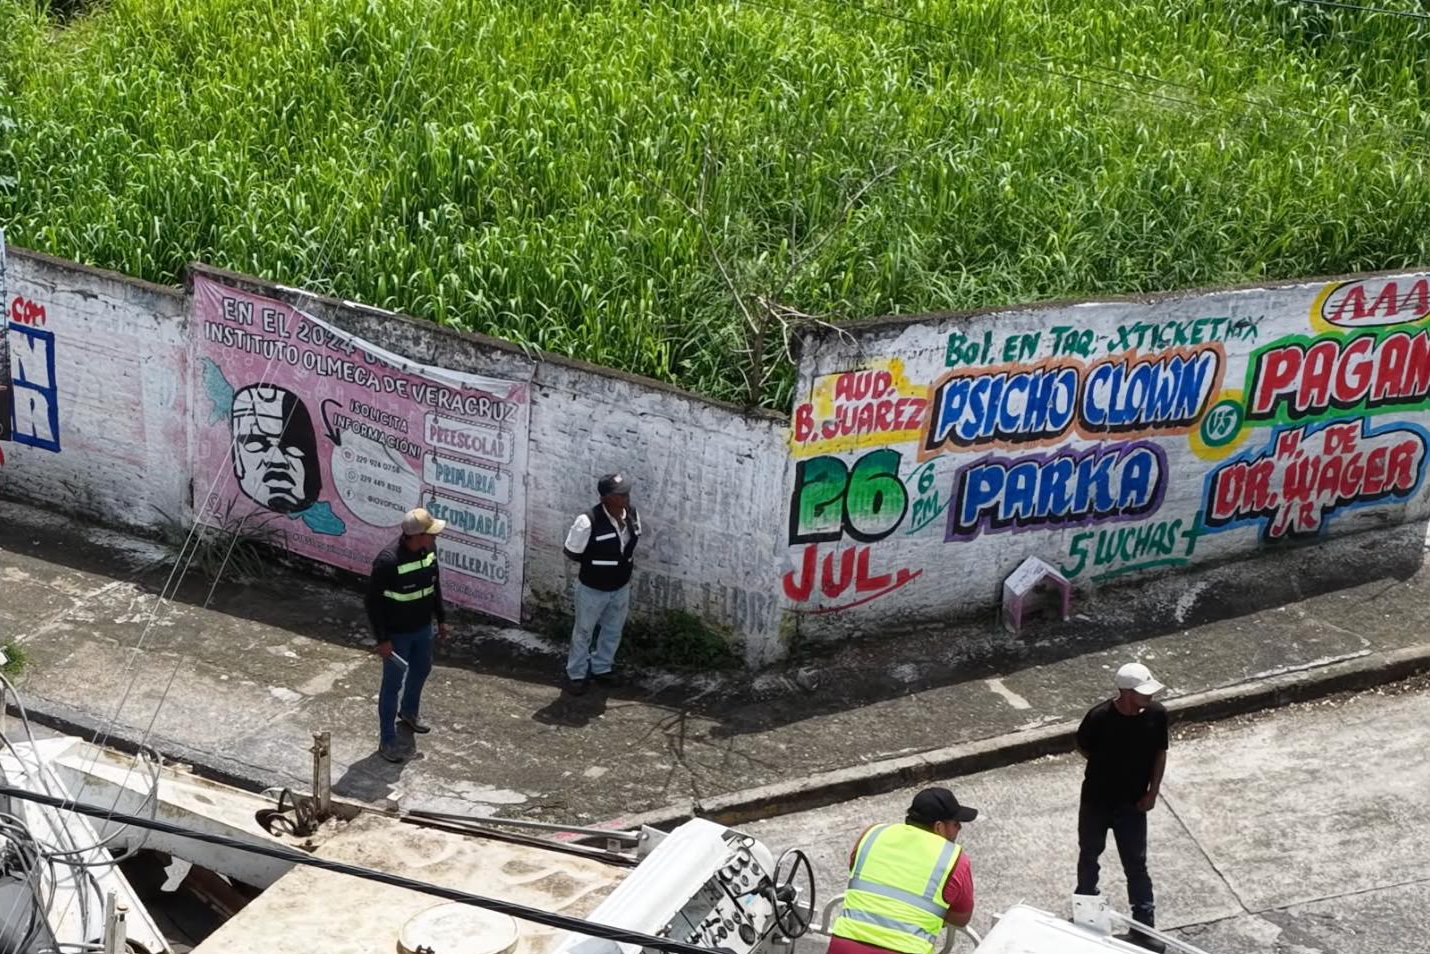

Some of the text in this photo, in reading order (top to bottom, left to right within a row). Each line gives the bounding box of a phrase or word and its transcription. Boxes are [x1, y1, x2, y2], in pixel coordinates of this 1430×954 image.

[222, 296, 254, 326] EN
[262, 308, 291, 339] EL
[1003, 331, 1041, 362] EN
[204, 320, 300, 366] INSTITUTO
[302, 350, 381, 393] OLMECA
[382, 373, 411, 400] DE
[411, 381, 519, 425] VERACRUZ
[835, 371, 896, 400] AUD.
[934, 350, 1217, 443] PSICHO CLOWN
[795, 397, 927, 443] B. JUAREZ
[430, 423, 505, 459] PREESCOLAR
[1324, 424, 1359, 456] DE
[435, 462, 496, 496] PRIMARIA
[789, 449, 908, 546] 26
[916, 462, 935, 494] 6
[960, 449, 1153, 527] PARKA
[426, 501, 507, 540] SECUNDARIA
[437, 548, 505, 580] CHILLERATO
[1060, 531, 1095, 579] 5
